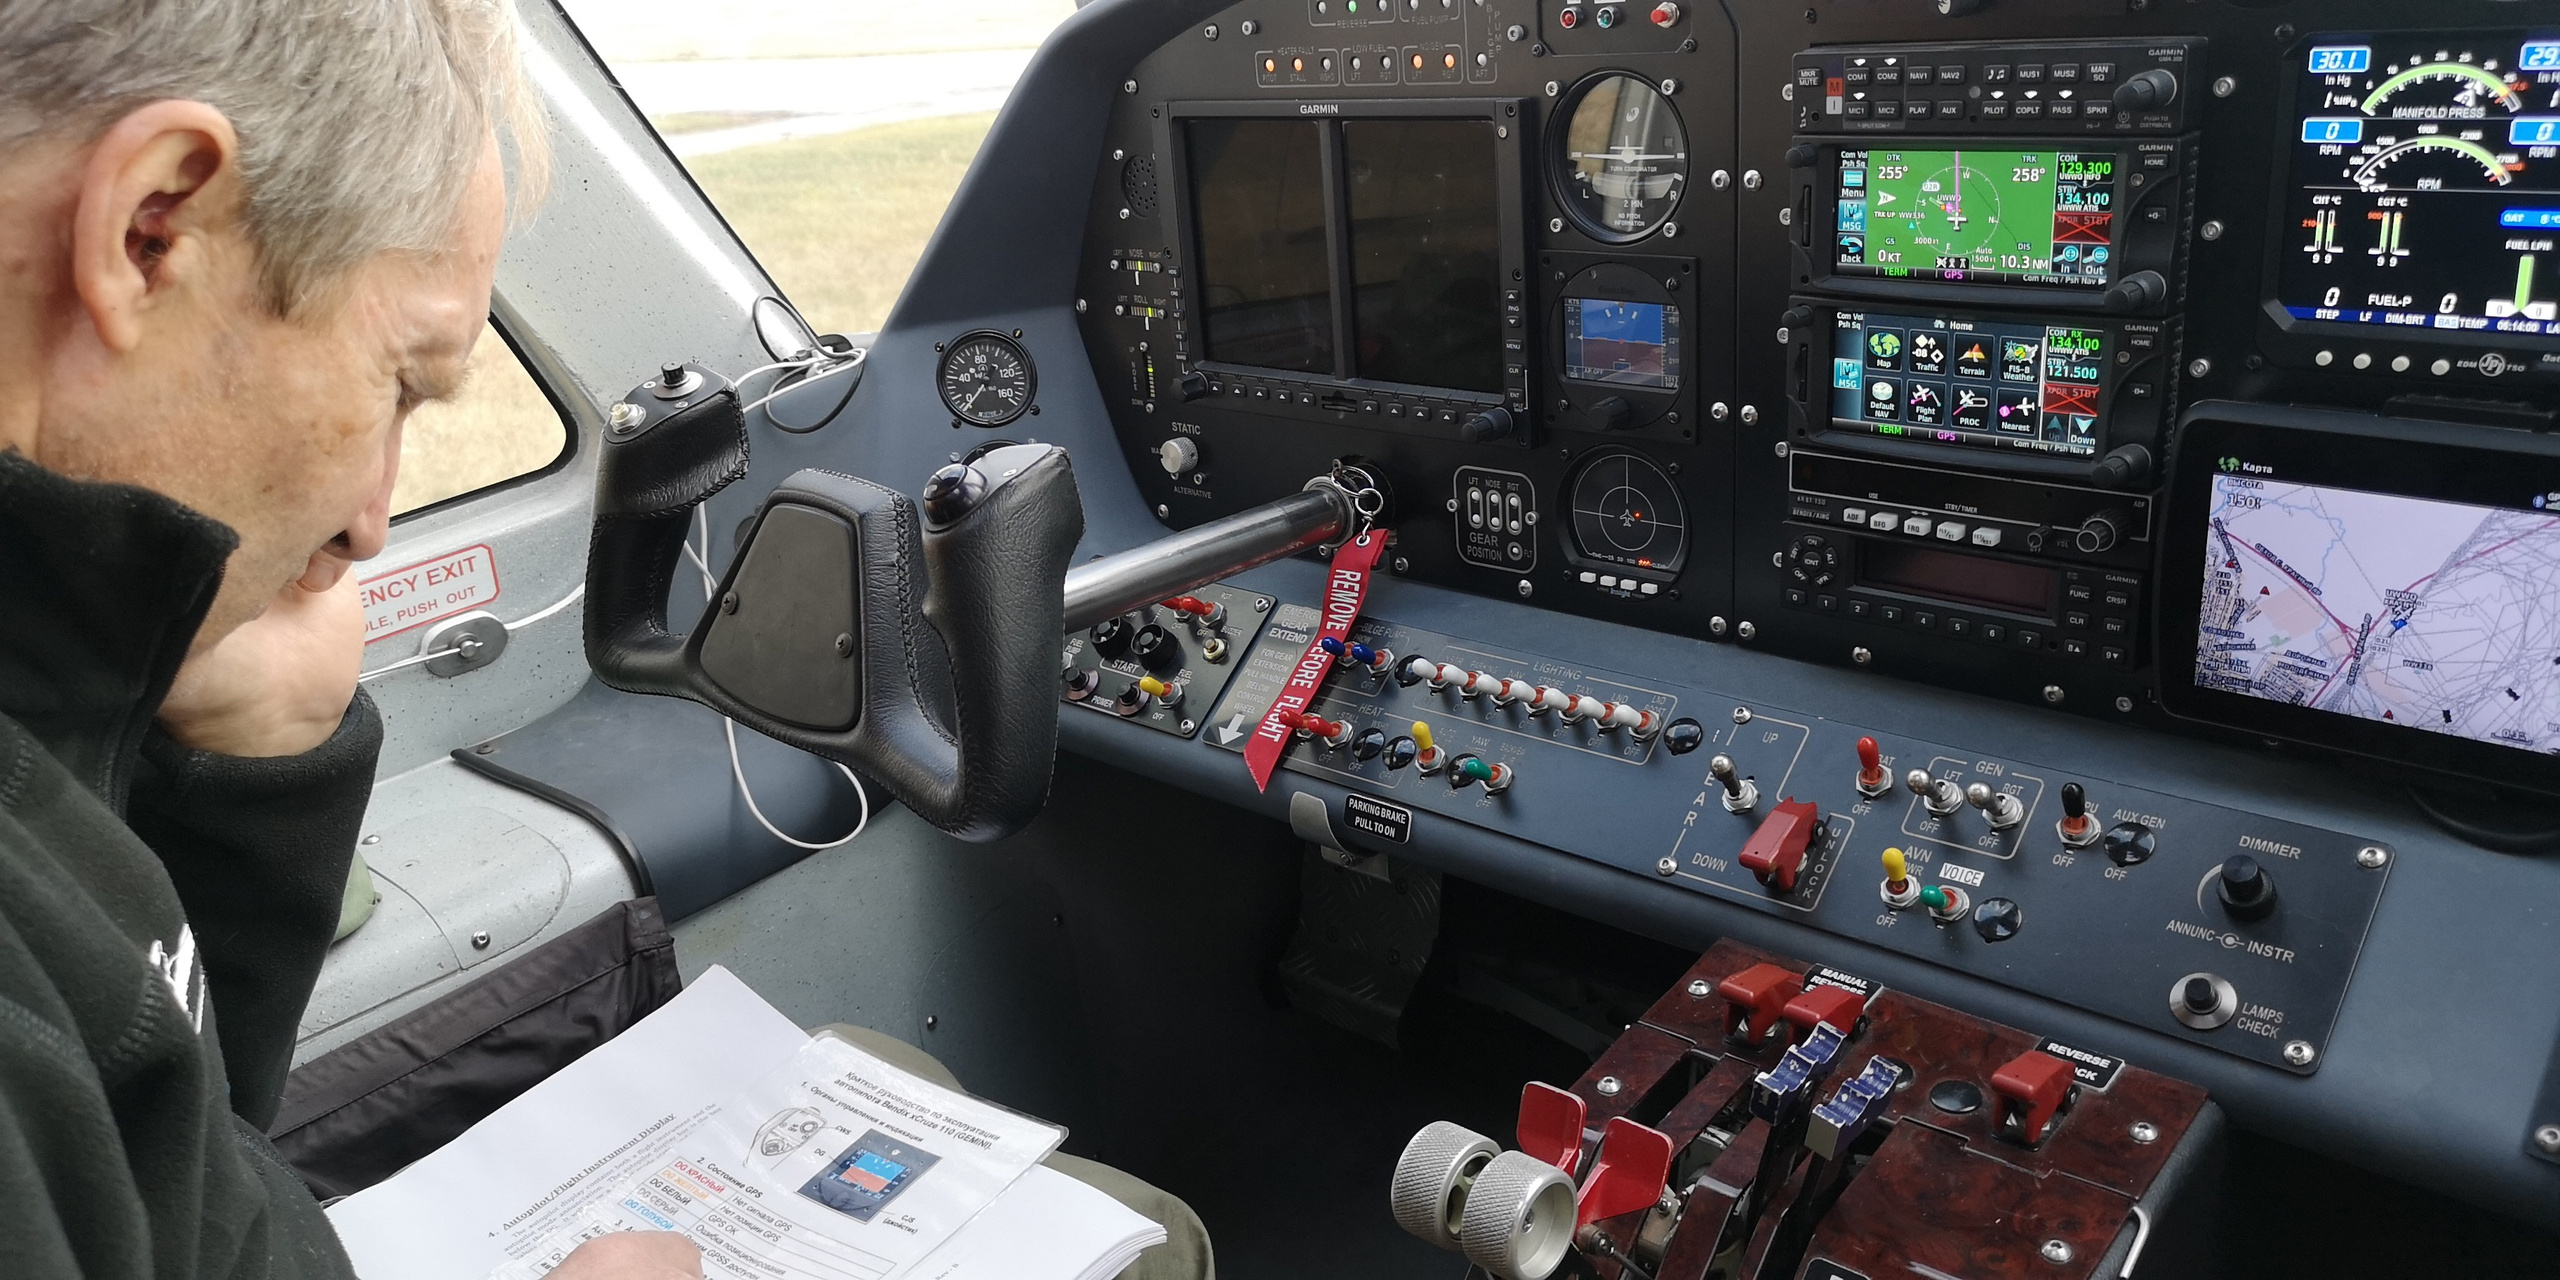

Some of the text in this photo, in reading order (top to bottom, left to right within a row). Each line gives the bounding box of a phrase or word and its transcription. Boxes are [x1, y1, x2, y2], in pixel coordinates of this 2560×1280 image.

[2318, 52, 2357, 69] 30.1
[1847, 73, 1866, 81] COM1
[1877, 72, 1897, 80] COM2
[1300, 105, 1338, 114] GARMIN
[2392, 107, 2485, 118] MANIFOLD PRESS
[2326, 123, 2339, 139] 0
[2319, 146, 2341, 155] RPM
[2060, 163, 2111, 174] 129.300
[2417, 179, 2441, 189] RPM
[1583, 189, 1589, 198] L
[1671, 191, 1676, 200] R
[1842, 189, 1864, 197] Menu
[2058, 193, 2109, 205] 134.100
[1843, 222, 1861, 230] MSG
[1841, 255, 1861, 263] Back
[1888, 254, 1901, 262] KT
[2000, 256, 2048, 269] 10.3 NM
[1883, 267, 1908, 276] TERM
[1945, 271, 1963, 279] GPS
[2061, 265, 2070, 273] In
[2086, 266, 2103, 274] Out
[2316, 310, 2339, 319] STEP
[1950, 321, 1973, 330] Home
[2459, 319, 2488, 329] TEMP
[2050, 337, 2099, 350] 134.100
[975, 355, 986, 364] 80
[1877, 359, 1891, 368] Map
[2047, 358, 2066, 366] STBY
[1000, 369, 1014, 377] 120
[1916, 363, 1939, 371] Traffic
[1960, 367, 1985, 376] Terrain
[2048, 367, 2097, 379] 121.500
[959, 374, 970, 382] 40
[2003, 372, 2034, 381] Weather
[998, 388, 1013, 397] 160
[1870, 402, 1894, 410] Default
[1916, 406, 1935, 415] Flight
[1875, 410, 1889, 418] NAV
[1960, 418, 1980, 426] PROC
[2002, 422, 2030, 431] Nearest
[1172, 422, 1200, 435] STATIC
[1878, 425, 1902, 434] TERM
[1937, 431, 1955, 440] GPS
[2071, 435, 2095, 445] Down
[2243, 462, 2273, 473] Карта
[1469, 477, 1479, 485] LFT
[1485, 478, 1500, 488] NOSE
[1507, 482, 1519, 491] RGT
[2228, 479, 2263, 489] ВЫСОТА
[1174, 486, 1212, 498] ALTERNATIVE
[1470, 532, 1499, 547] GEAR
[1467, 545, 1502, 561] POSITION
[426, 556, 477, 586] EXIT
[1326, 569, 1361, 631] REMOVE
[2070, 589, 2089, 599] FUNC
[397, 586, 476, 620] PUSH OUT
[1283, 607, 1316, 619] EMERG
[1281, 619, 1308, 631] GEAR
[2069, 616, 2084, 625] CLR
[1221, 626, 1242, 635] BUZZER
[2106, 623, 2121, 632] ENT
[1269, 628, 1308, 644] EXTEND
[1112, 659, 1139, 672] START
[1253, 659, 1289, 672] EXTENSION
[1291, 639, 1330, 689] EFORE
[1533, 662, 1582, 680] LIGHTING
[1237, 691, 1265, 703] CONTROL
[1358, 704, 1384, 717] HEAT
[1762, 732, 1778, 743] UP
[1975, 761, 2004, 776] GEN
[1943, 770, 1962, 782] LFT
[2002, 783, 2023, 796] RGT
[1349, 798, 1406, 824] PARKING BRAKE
[1852, 804, 1872, 816] OFF
[2113, 809, 2166, 829] AUX GEN
[1355, 816, 1396, 838] PULL TO ON
[1919, 821, 1940, 833] OFF
[1979, 836, 1999, 848] OFF
[2239, 836, 2301, 859] DIMMER
[1903, 846, 1932, 862] AVN
[1692, 853, 1727, 872] DOWN
[2052, 854, 2075, 867] OFF
[1941, 864, 1982, 885] VOICE
[2104, 868, 2127, 880] OFF
[1876, 915, 1897, 928] OFF
[2166, 920, 2295, 963] ANNUNC INSTR
[1820, 968, 1867, 989] MANUAL
[2242, 1002, 2283, 1024] LAMPS
[2236, 1017, 2280, 1039] CHECK
[2047, 1043, 2111, 1068] REVERSE
[833, 1079, 881, 1104] автопилота
[881, 1100, 909, 1118] Bendix
[910, 1113, 939, 1130] xCruze
[939, 1125, 952, 1135] 110
[846, 1072, 1001, 1141] Краткое руководство по эксплуатации
[811, 1087, 837, 1103] Органы
[836, 1099, 879, 1124] управления
[885, 1123, 924, 1143] индикации
[836, 1125, 851, 1135] CWS
[502, 1168, 584, 1231] Autopilot/Flight
[583, 1136, 640, 1174] Instrument
[639, 1112, 676, 1139] Display
[675, 1161, 725, 1193] DG КРАСНЫЙ
[707, 1163, 763, 1198] Состояние GPS
[650, 1178, 692, 1205] DG БЕЛЫЙ
[625, 1200, 674, 1230] DG ГОЛУБОЙ
[733, 1196, 792, 1232] Нет сигнала GPS
[709, 1215, 740, 1236] GPS OK
[696, 1225, 723, 1245] Ошибка
